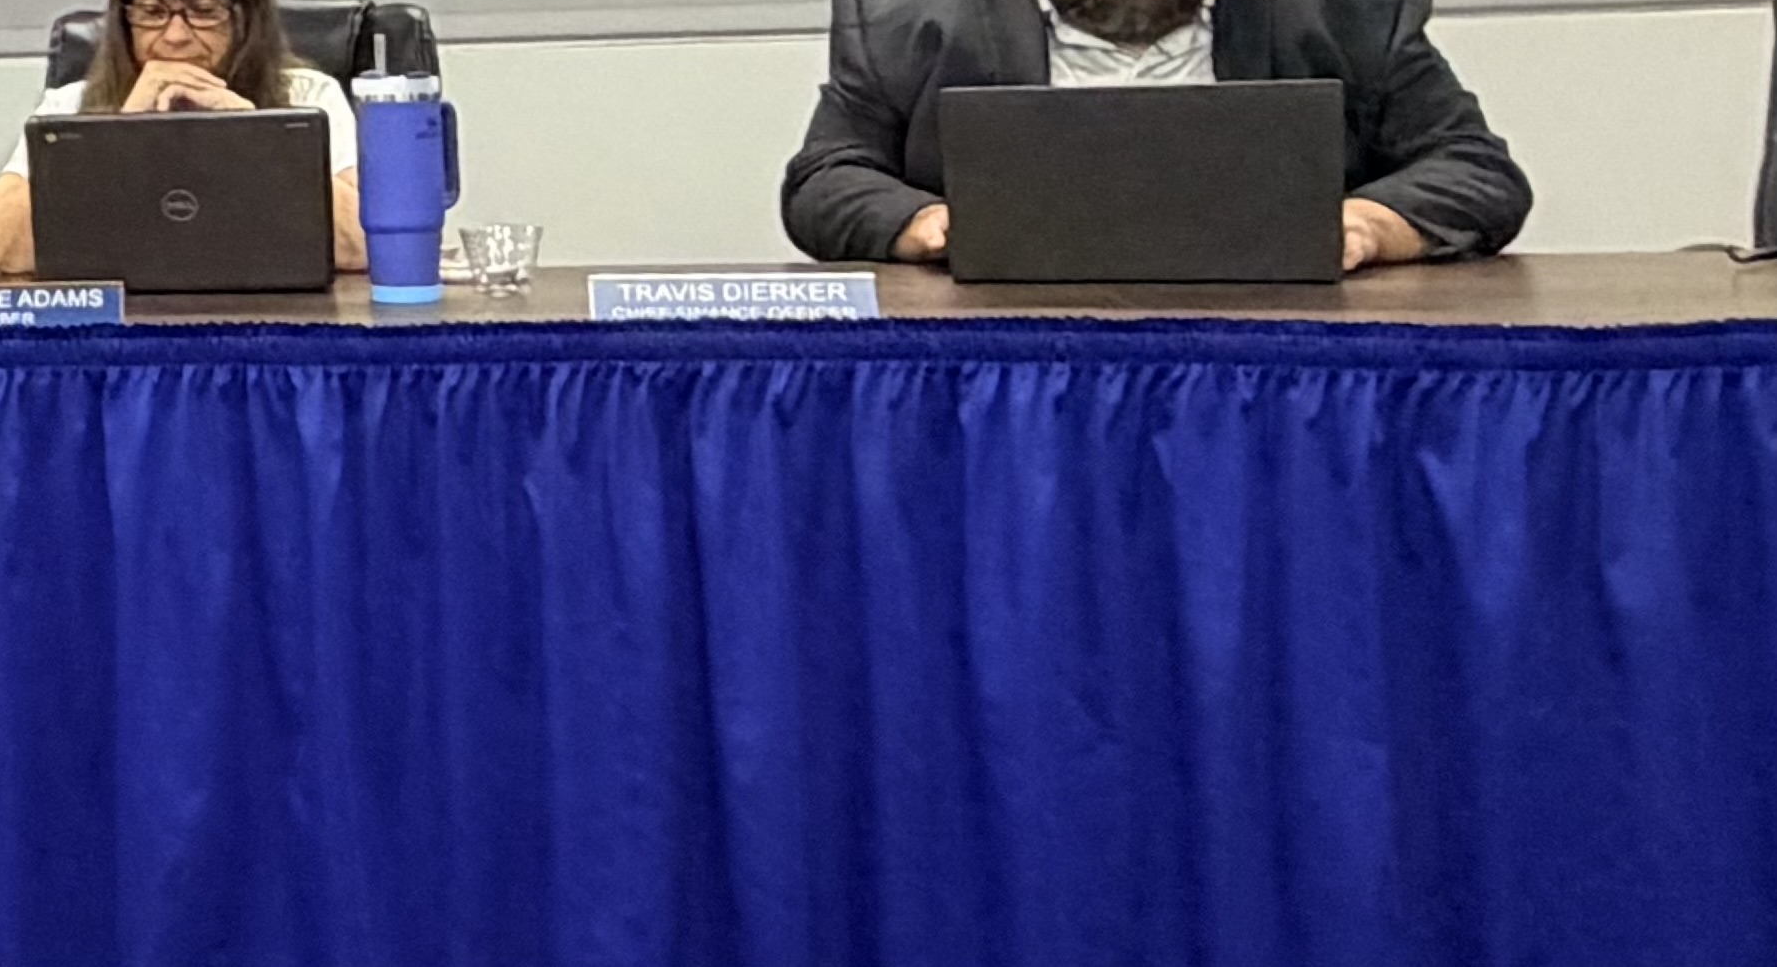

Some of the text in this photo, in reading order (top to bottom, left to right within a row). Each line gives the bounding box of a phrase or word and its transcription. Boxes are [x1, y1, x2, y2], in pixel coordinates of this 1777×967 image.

[17, 288, 104, 308] ADAMS
[618, 282, 848, 302] TRAVIS DIERKER
